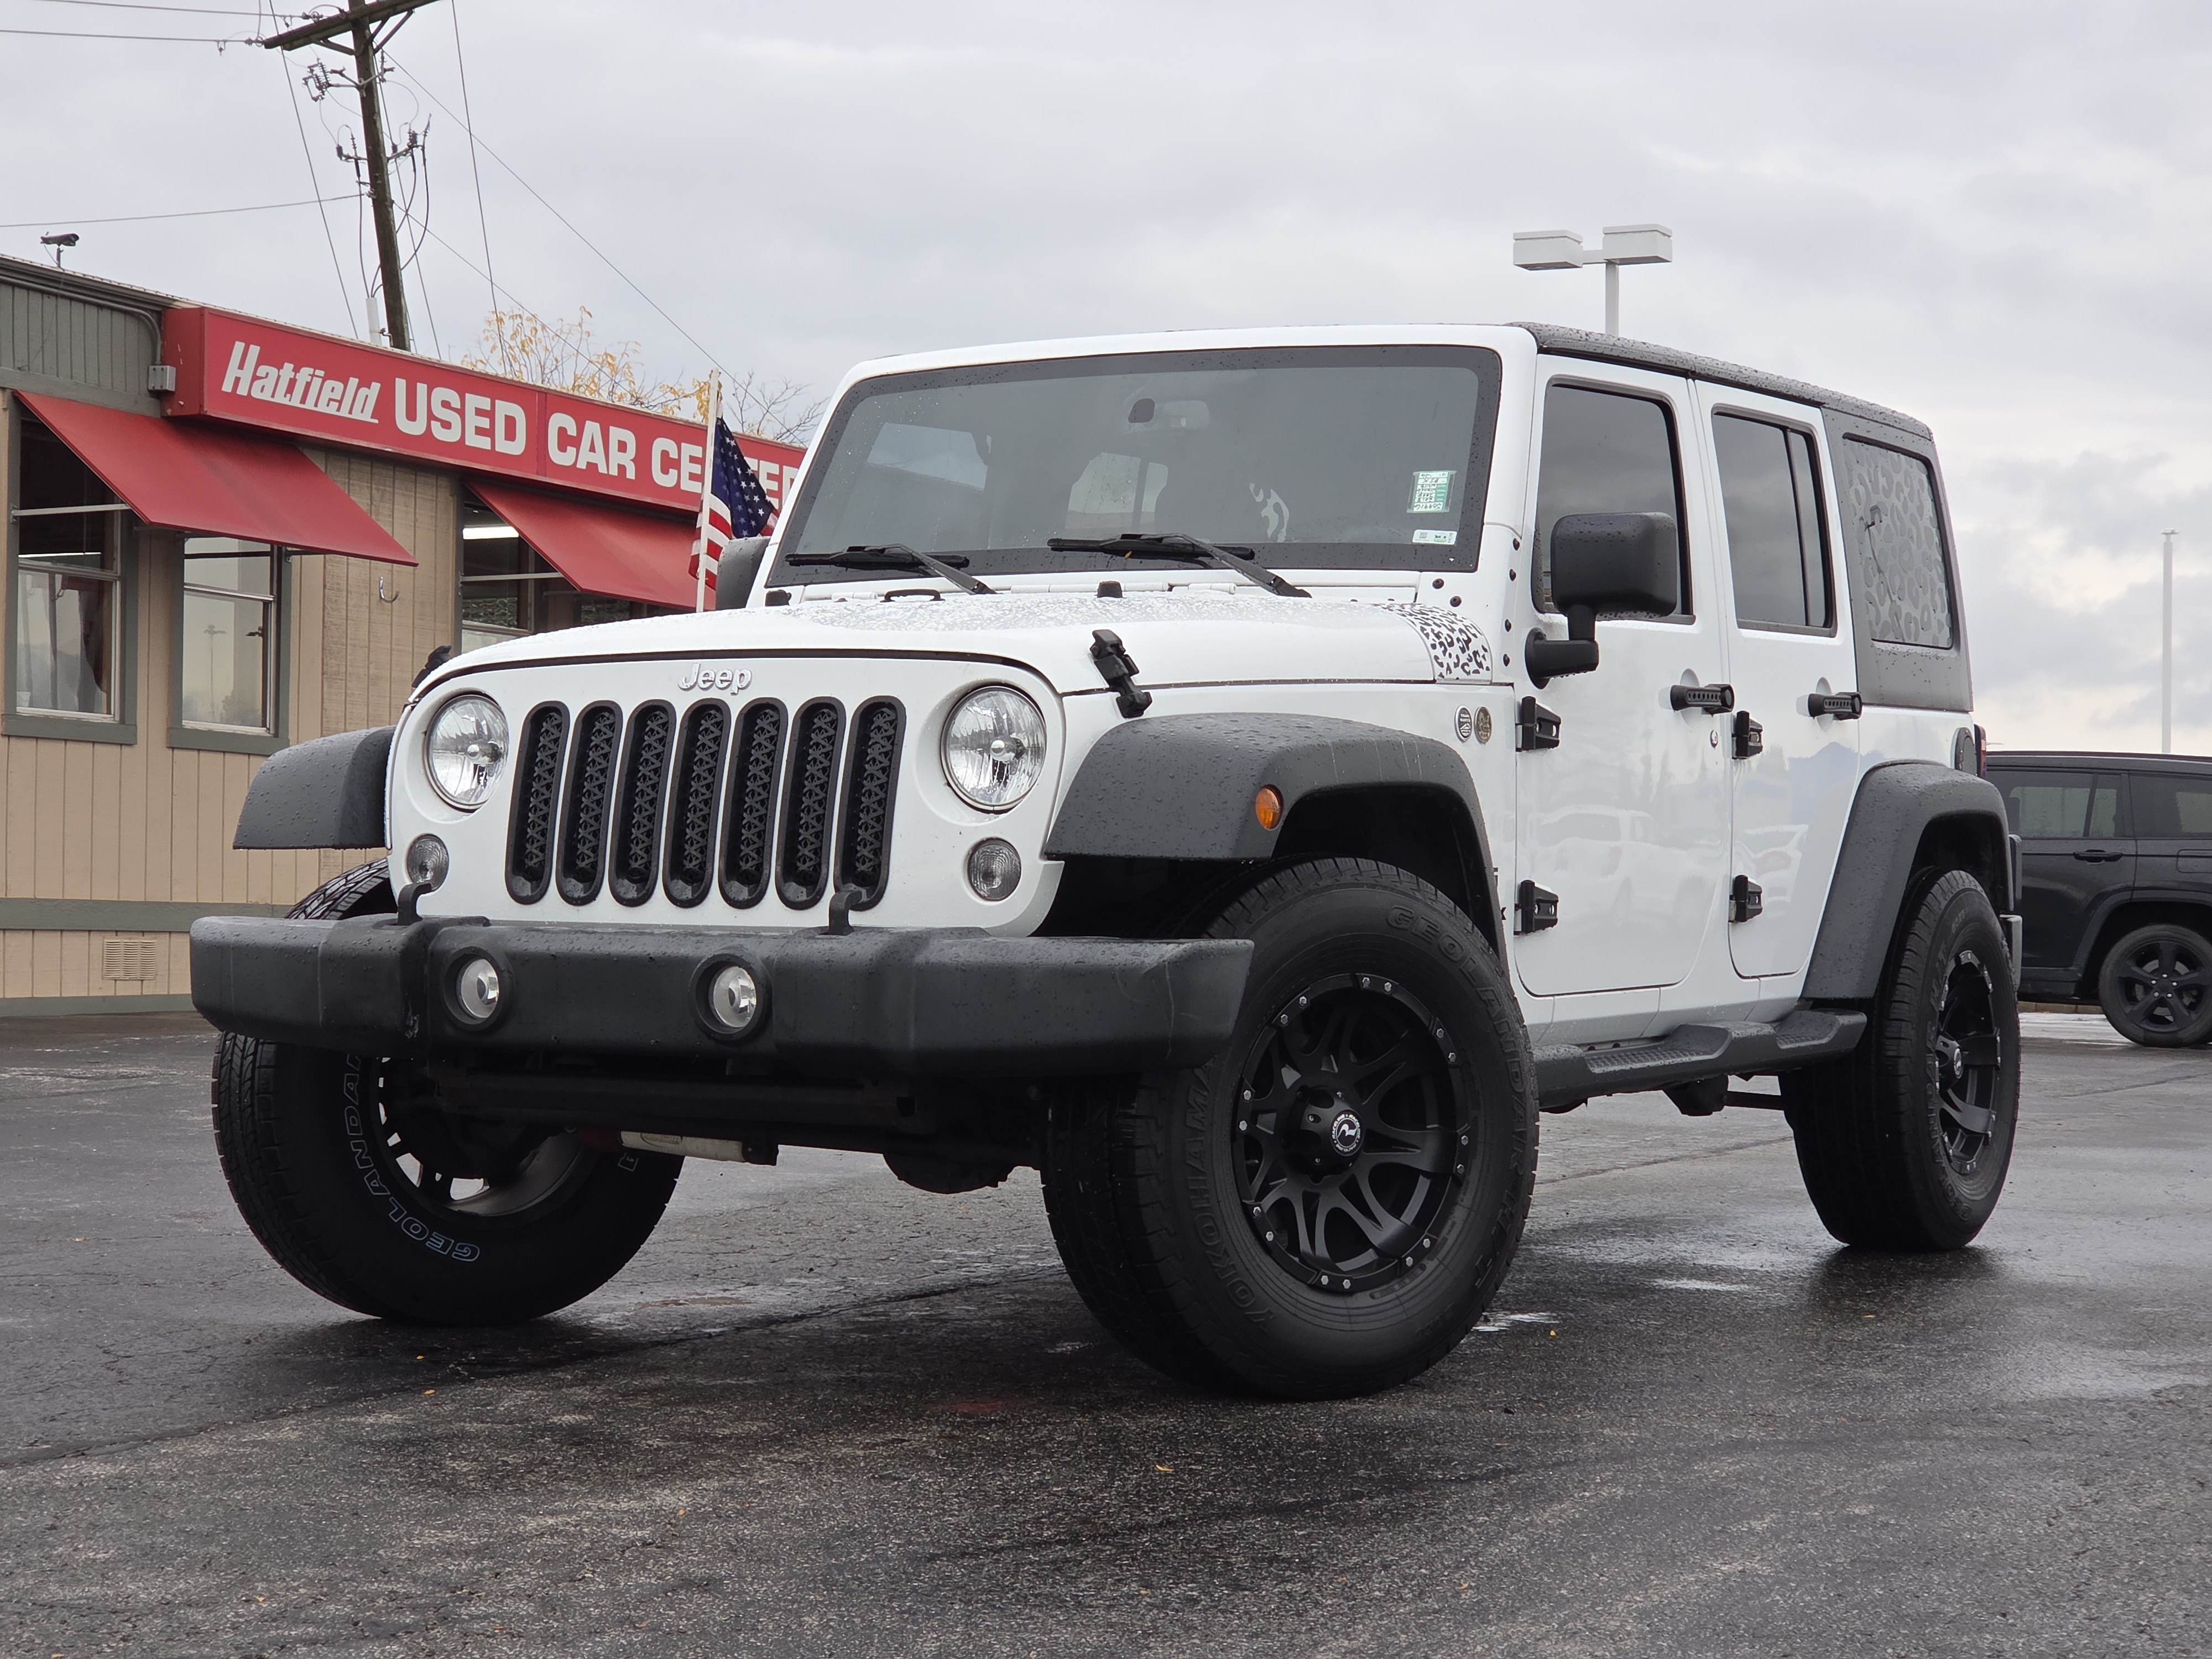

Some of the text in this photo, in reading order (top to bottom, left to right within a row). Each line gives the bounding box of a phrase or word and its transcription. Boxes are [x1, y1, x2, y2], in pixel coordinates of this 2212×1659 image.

[221, 341, 381, 424] Hatfield
[395, 377, 526, 456] USED
[547, 412, 636, 480] CAR
[677, 662, 752, 696] Jeep
[1386, 904, 1527, 1177] GEOLANDAR
[1185, 1055, 1274, 1333] YOKOHAMA
